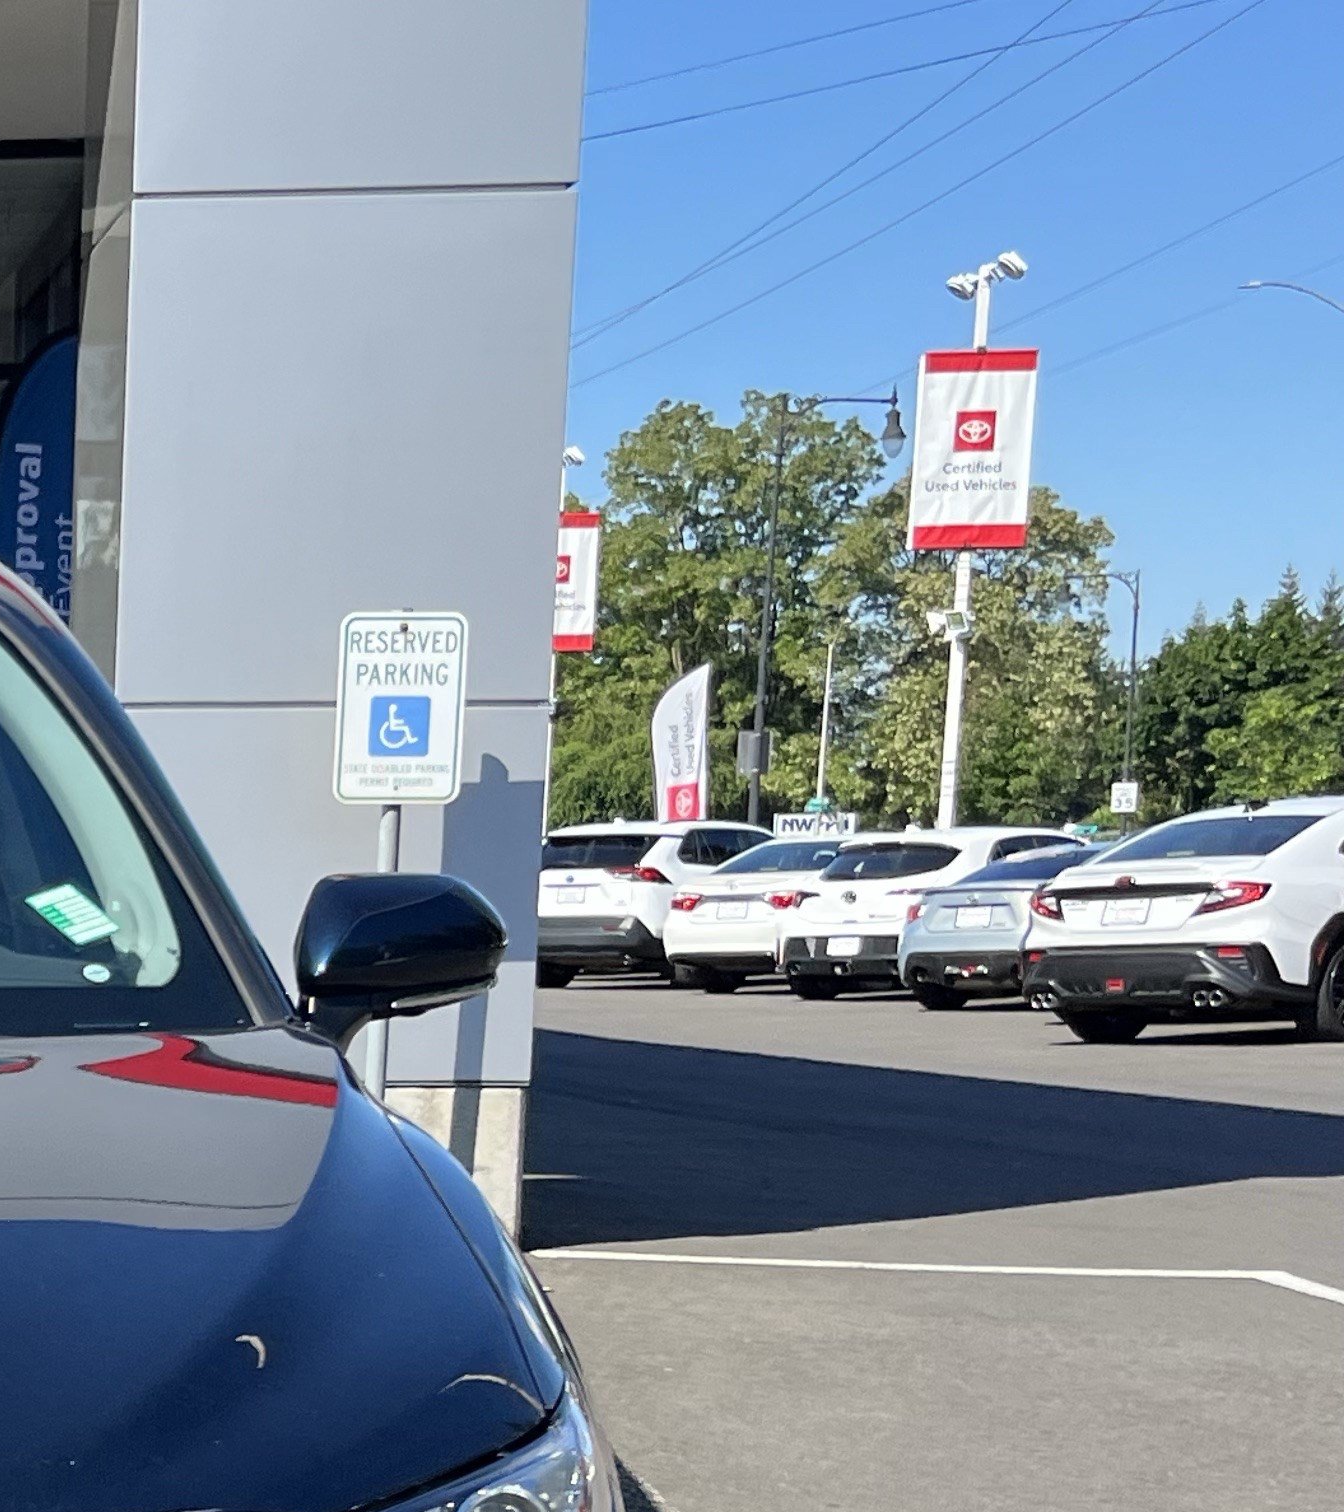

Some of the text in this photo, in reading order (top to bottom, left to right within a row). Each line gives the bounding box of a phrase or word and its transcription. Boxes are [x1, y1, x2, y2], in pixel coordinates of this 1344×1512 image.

[943, 461, 1002, 474] Certified
[925, 478, 1017, 492] Used Vehicles
[350, 630, 459, 653] RESERVED
[356, 662, 450, 686] PARKING
